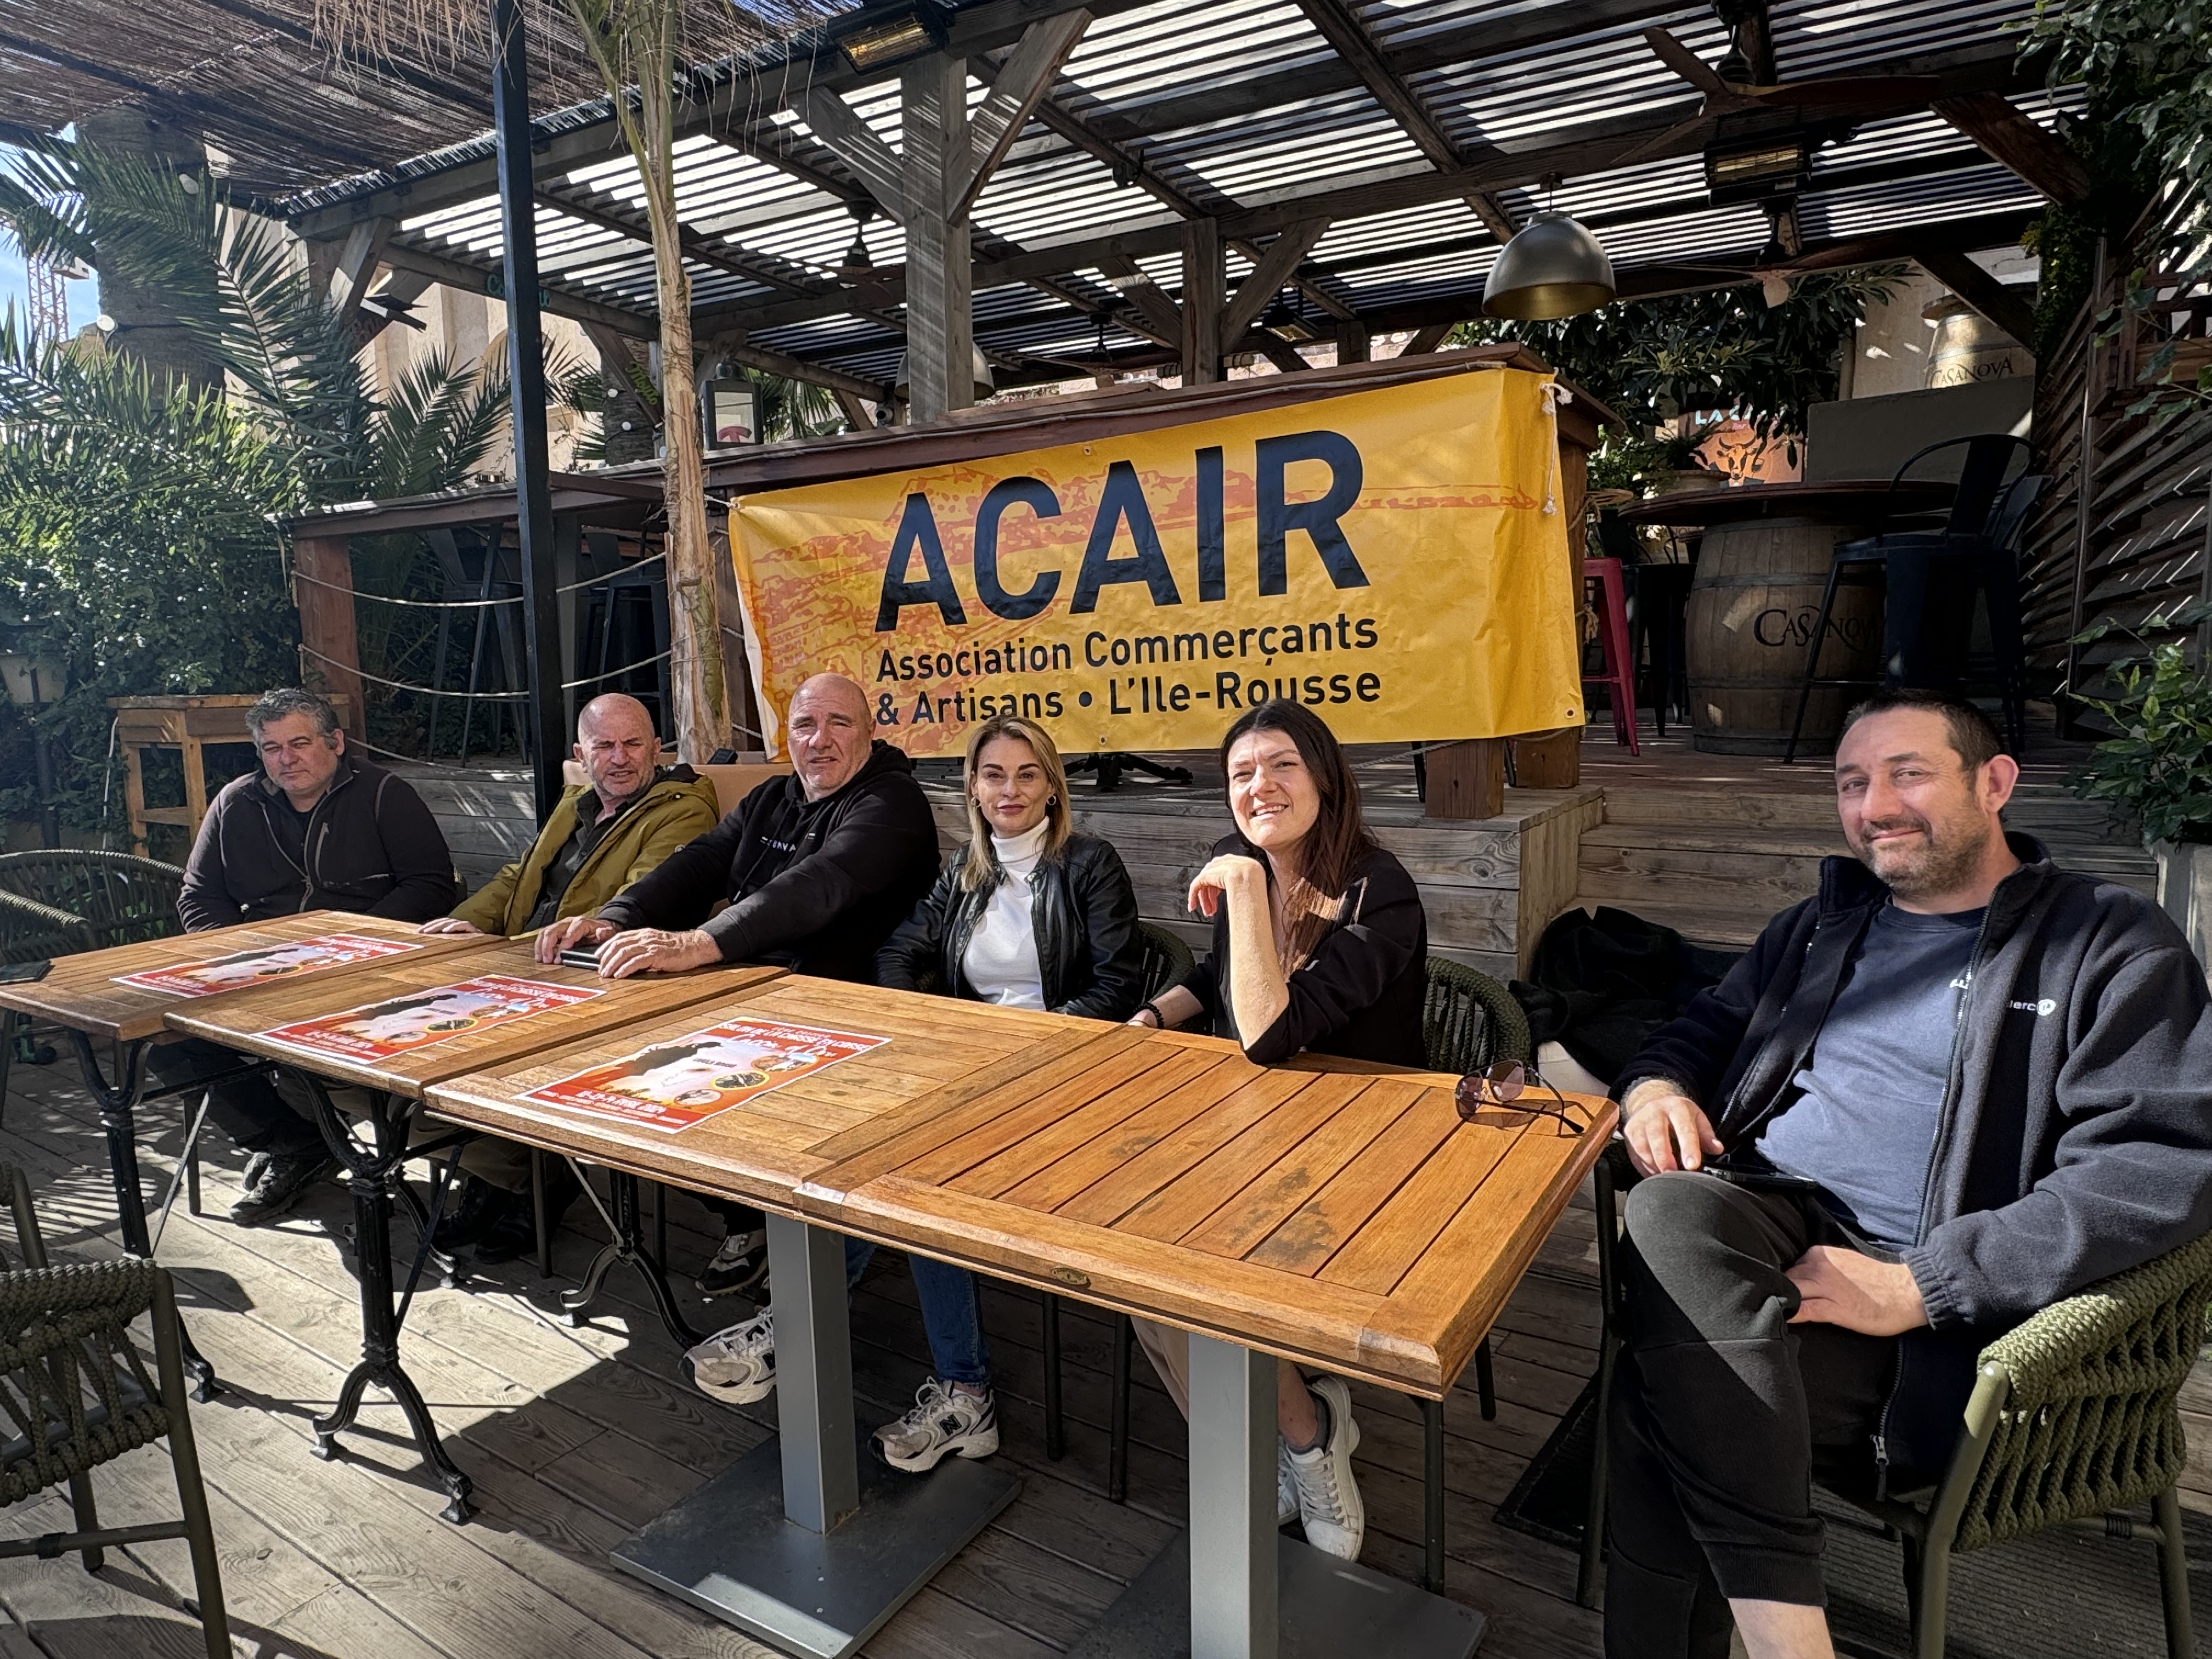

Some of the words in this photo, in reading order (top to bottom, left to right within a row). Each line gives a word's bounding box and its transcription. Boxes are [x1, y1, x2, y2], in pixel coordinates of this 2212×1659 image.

[1930, 356, 2015, 389] CASANOVA
[874, 430, 1371, 633] ACAIR
[876, 638, 1071, 683] Association
[1085, 613, 1379, 667] Commerçants
[1753, 605, 1878, 653] CASNOV
[876, 693, 899, 725] &
[912, 687, 1064, 725] Artisans
[1109, 670, 1381, 715] L'Ile-Rousse
[2006, 1000, 2036, 1011] lerc
